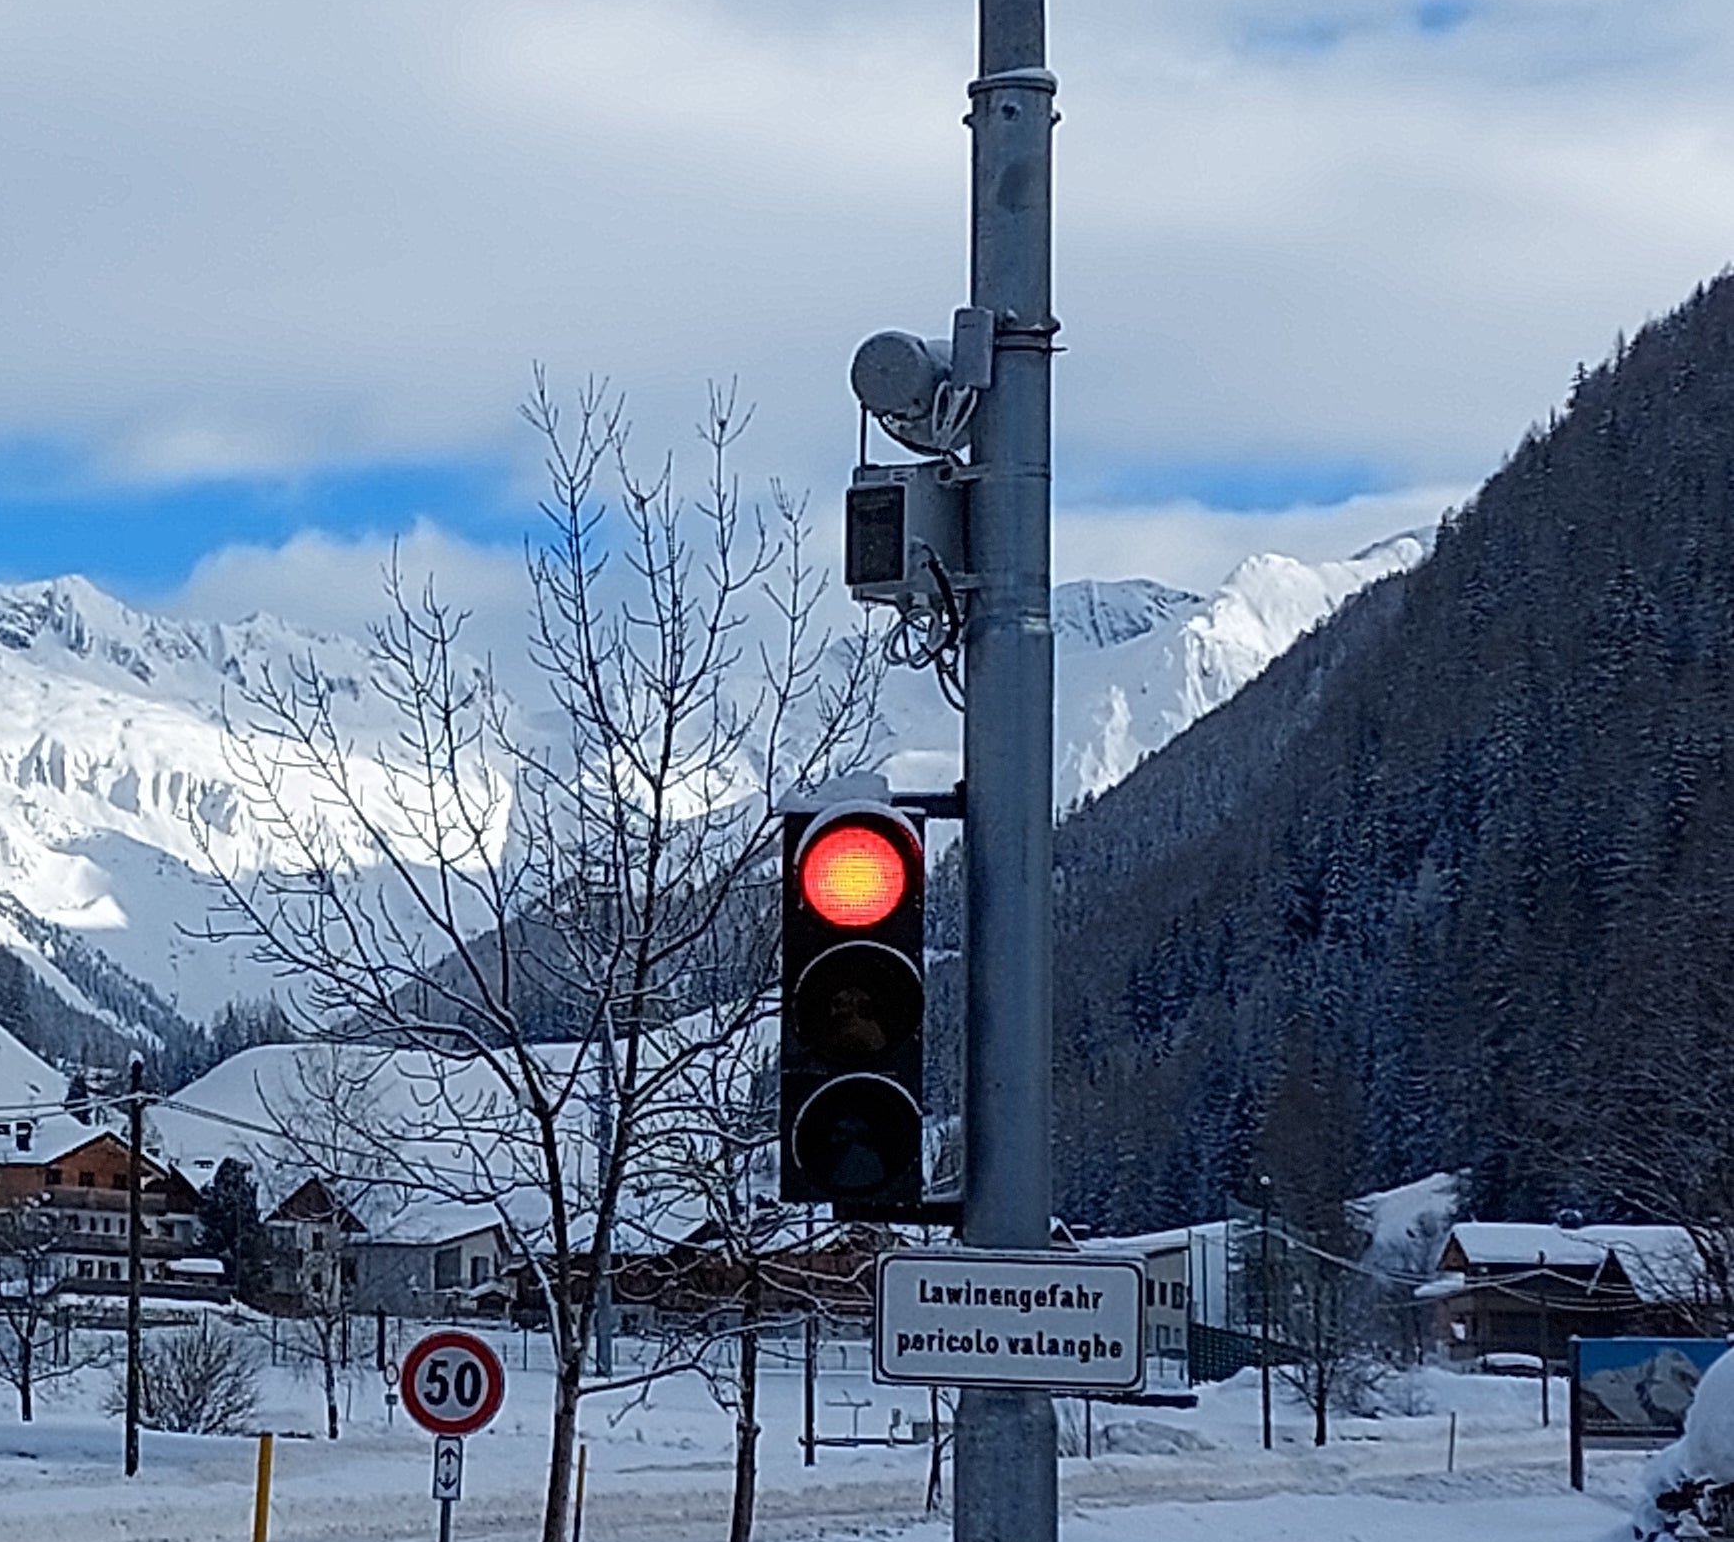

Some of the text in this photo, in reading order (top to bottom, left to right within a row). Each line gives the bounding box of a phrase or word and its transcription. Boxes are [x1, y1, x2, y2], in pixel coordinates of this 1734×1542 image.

[919, 1278, 1103, 1313] Lawinengefahr
[896, 1327, 1123, 1363] pericolo valanghe
[423, 1358, 482, 1408] 50
